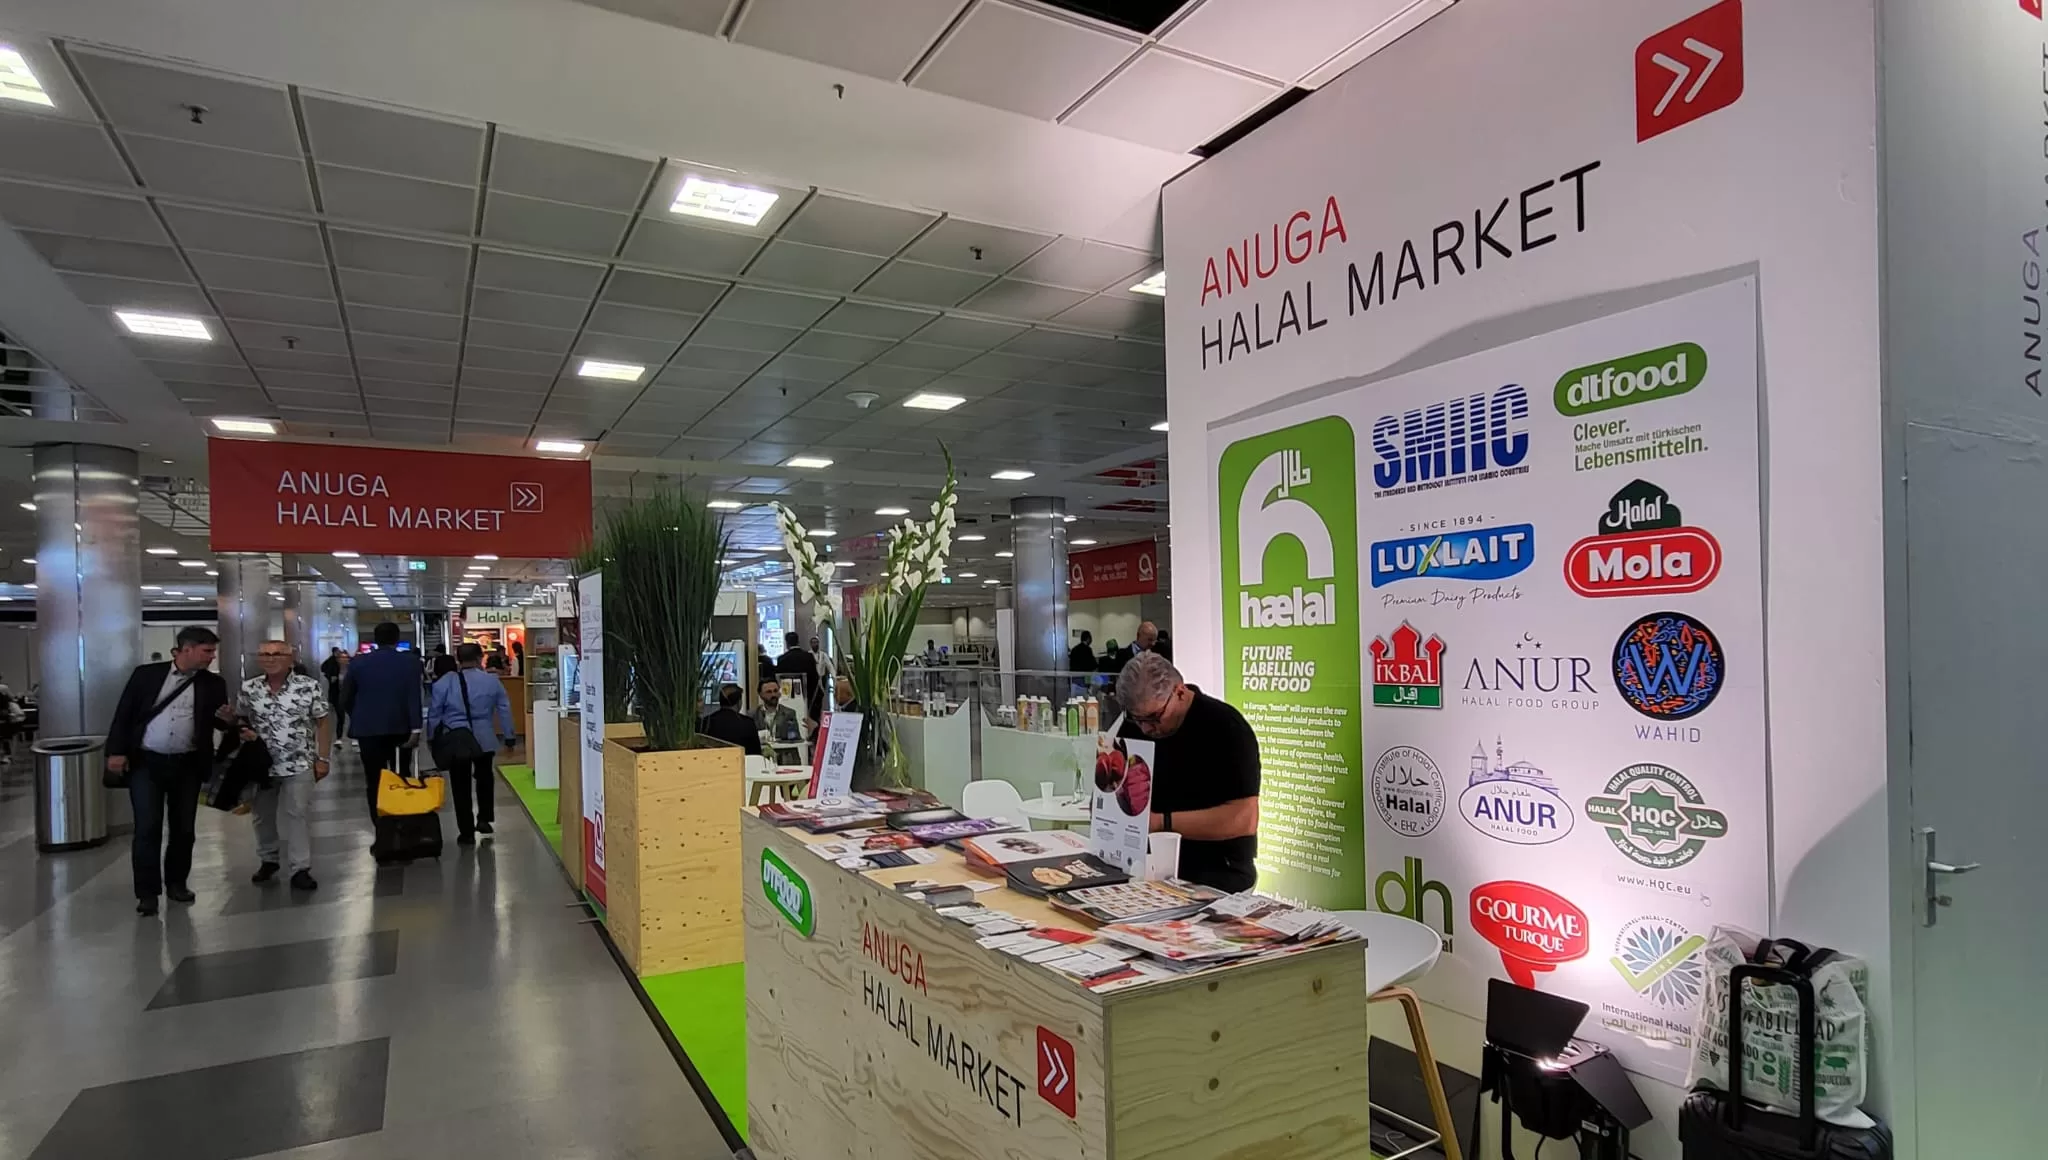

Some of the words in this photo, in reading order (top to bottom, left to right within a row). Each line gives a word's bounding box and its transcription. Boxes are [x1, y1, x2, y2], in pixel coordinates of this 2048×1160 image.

[1201, 195, 1347, 306] ANUGA
[1201, 280, 1328, 370] HALAL
[1348, 160, 1601, 317] MARKET
[2022, 228, 2042, 398] ANUGA
[1567, 352, 1687, 407] dtfood
[1372, 383, 1529, 489] SMIIC
[1573, 418, 1630, 442] Clever.
[1575, 443, 1602, 454] Mache
[1603, 436, 1634, 449] Umsatz
[1635, 431, 1650, 443] mit
[1652, 423, 1702, 440] türkischen
[1575, 436, 1709, 472] Lebensmitteln.
[276, 470, 390, 498] ANUGA
[1468, 474, 1478, 484] FOR
[276, 502, 378, 529] HALAL
[388, 505, 506, 532] MARKET
[1605, 495, 1662, 530] Halal
[1409, 519, 1447, 532] SINCE
[1453, 514, 1483, 527] 1894
[1378, 532, 1525, 574] LUXLAIT
[1588, 543, 1693, 583] Mola
[1381, 593, 1427, 609] Premium
[1430, 588, 1467, 610] Dairy
[1469, 584, 1524, 605] Products
[1241, 646, 1293, 661] FUTURE
[1241, 661, 1316, 678] LABELLING
[1461, 657, 1599, 694] ANUR
[1241, 677, 1268, 694] FOR
[1270, 677, 1312, 694] FOOD
[1323, 706, 1333, 714] the
[1461, 696, 1501, 707] HALAL
[1507, 697, 1544, 708] FOOD
[1551, 699, 1600, 711] GROUP
[1308, 717, 1333, 726] products
[1299, 728, 1323, 737] between
[1324, 730, 1335, 738] the
[1634, 724, 1701, 743] WAHID
[1316, 740, 1326, 749] the
[1270, 746, 1279, 755] the
[1296, 752, 1323, 761] openness,
[1323, 751, 1345, 764] health,
[1412, 751, 1433, 771] Halal
[1281, 769, 1291, 778] the
[1305, 772, 1336, 785] important
[1299, 762, 1322, 773] winning
[1322, 763, 1333, 772] the
[1333, 765, 1349, 775] trust
[1294, 783, 1326, 794] production
[1607, 772, 1631, 792] HALAL
[1629, 765, 1665, 777] QUALITY
[1664, 770, 1699, 801] CONTROL
[1296, 804, 1325, 818] Therefore,
[1325, 810, 1337, 819] the
[1321, 799, 1346, 809] covered
[1386, 794, 1430, 814] Halal
[1474, 795, 1557, 829] ANUR
[1587, 804, 1618, 816] HALAL
[1314, 819, 1329, 829] food
[1400, 819, 1418, 832] EHZ
[1630, 805, 1677, 828] HQC
[1294, 826, 1304, 836] for
[1304, 830, 1341, 843] consumption
[1490, 823, 1514, 833] HALAL
[1516, 827, 1538, 836] FOOD
[1315, 842, 1345, 857] However,
[1330, 867, 1342, 879] for
[1617, 874, 1692, 895] www.HQC.eu
[1475, 896, 1583, 939] GOURME
[1502, 924, 1565, 953] TURQUE
[862, 921, 928, 997] ANUGA
[1602, 1001, 1664, 1027] International
[1666, 1021, 1692, 1036] Halal
[862, 970, 920, 1048] HALAL
[927, 1015, 1026, 1129] MARKET
